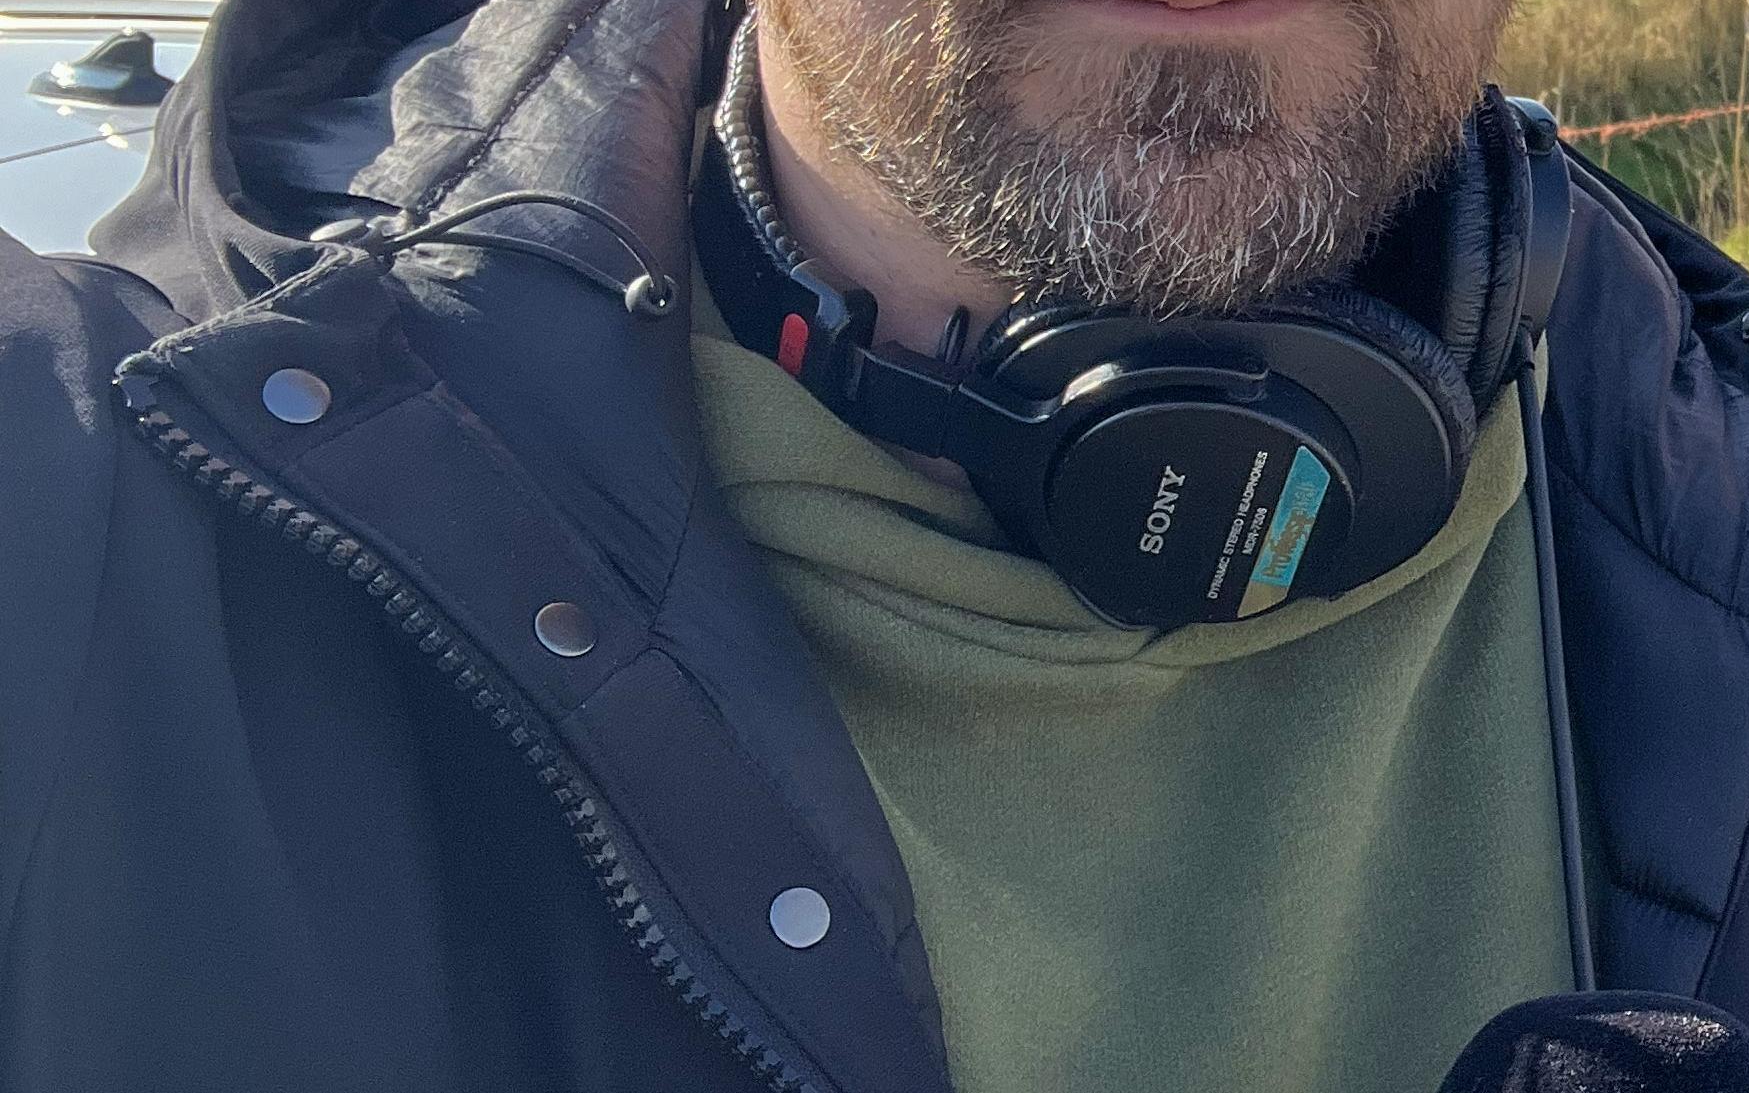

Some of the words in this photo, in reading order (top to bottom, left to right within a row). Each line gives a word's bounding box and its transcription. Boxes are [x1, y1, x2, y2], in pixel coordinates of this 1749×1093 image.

[1140, 465, 1186, 555] SONY
[1207, 557, 1231, 600] DYNAMIC
[1222, 516, 1245, 557] STEREO
[1237, 450, 1268, 517] HEADPHONES
